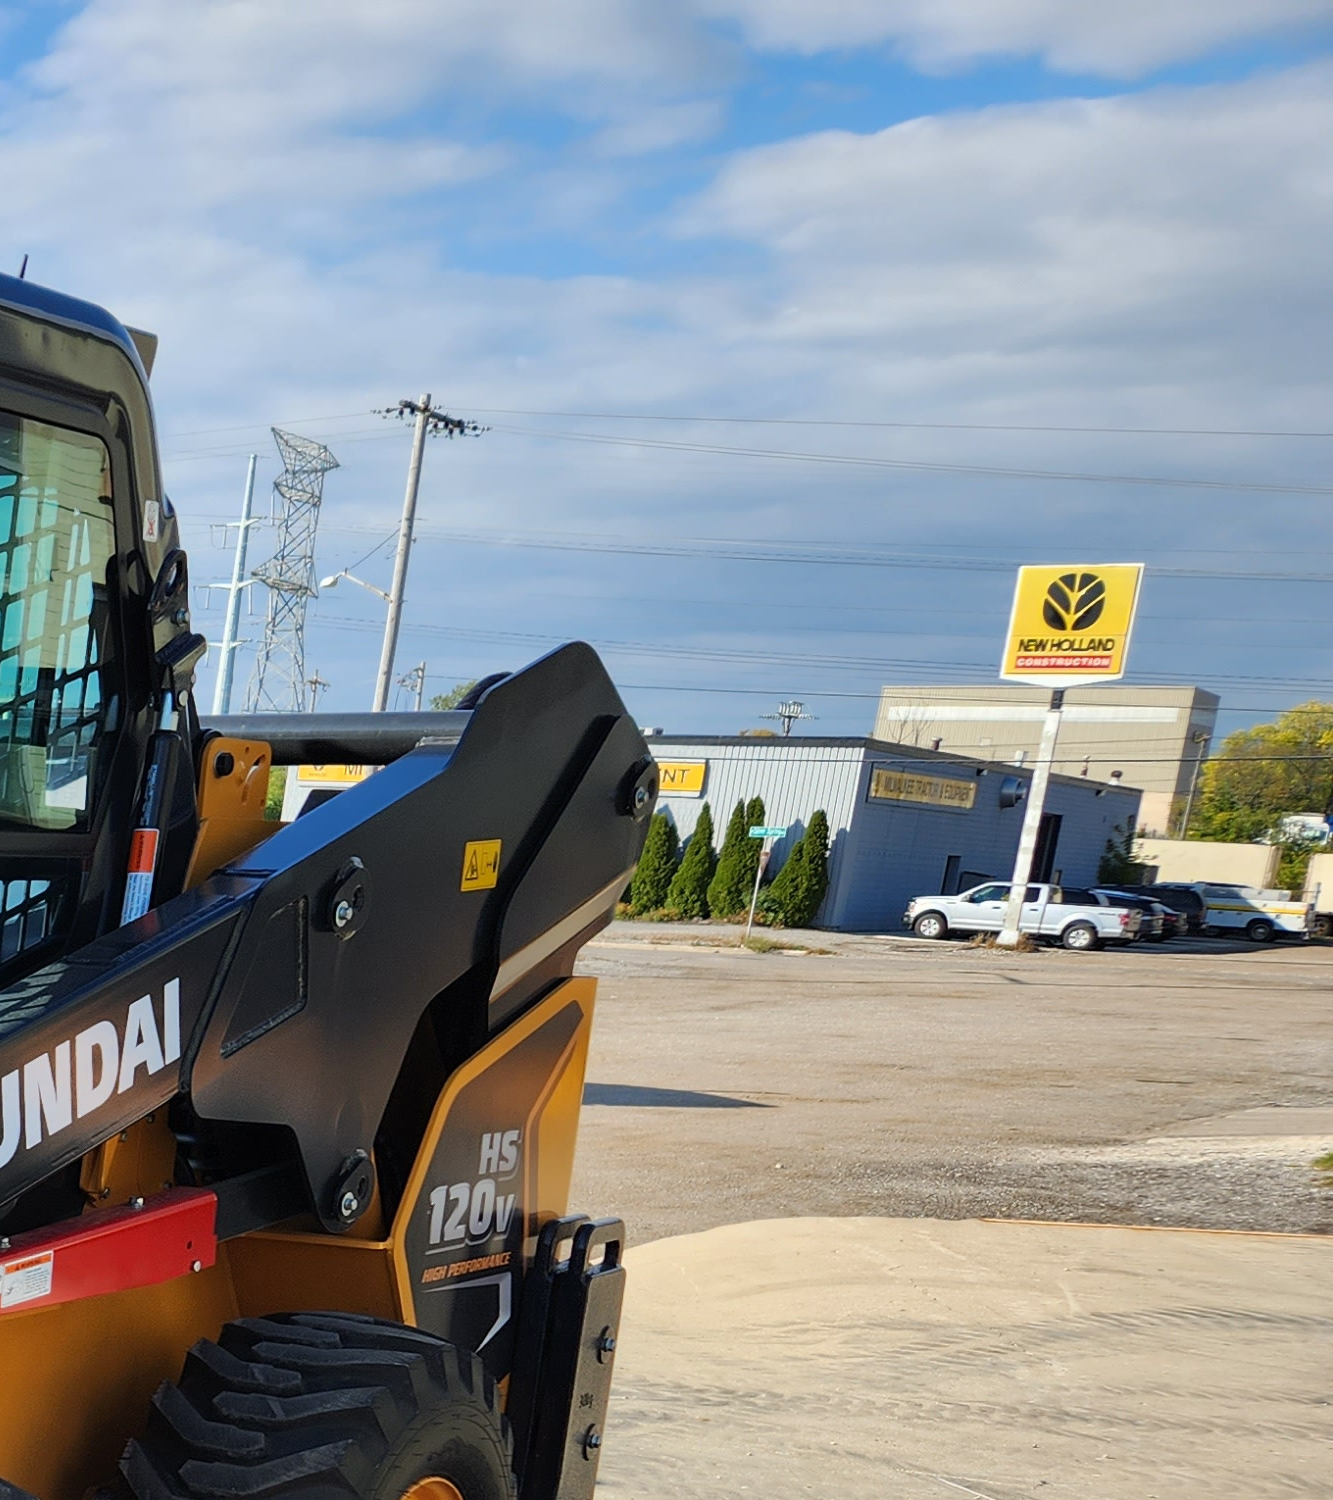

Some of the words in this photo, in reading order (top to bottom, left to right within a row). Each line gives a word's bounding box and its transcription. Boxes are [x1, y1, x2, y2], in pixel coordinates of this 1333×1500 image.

[1018, 638, 1048, 652] NEW
[1049, 638, 1115, 652] HOLLAND
[1016, 657, 1110, 667] CONSTRUCTION
[659, 768, 690, 784] NT
[478, 1130, 520, 1174] HS
[421, 1265, 448, 1283] HIGH
[447, 1251, 512, 1278] PERFORMANCE
